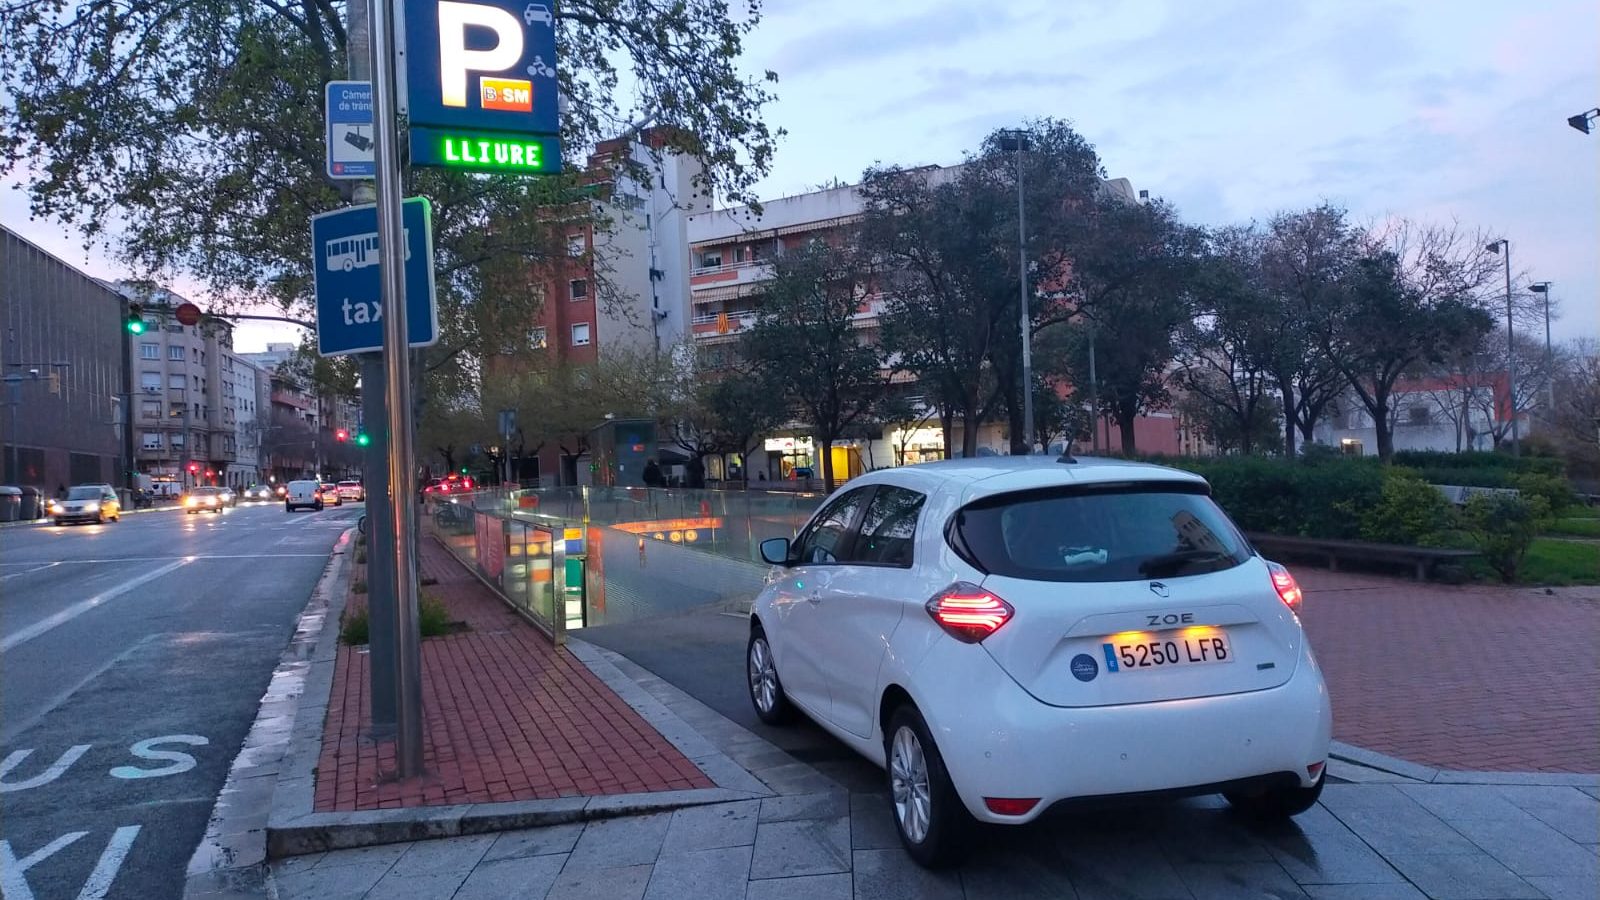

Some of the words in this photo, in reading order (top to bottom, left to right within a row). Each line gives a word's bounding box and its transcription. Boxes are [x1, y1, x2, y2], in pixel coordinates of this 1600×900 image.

[438, 1, 523, 107] P
[338, 101, 350, 110] de
[342, 90, 371, 99] Càmer
[445, 139, 540, 166] LLIURE
[341, 297, 383, 325] tax
[1147, 613, 1195, 626] ZOE
[1109, 660, 1115, 668] E
[1120, 641, 1179, 668] 5250
[1185, 637, 1227, 662] LFB
[0, 734, 209, 793] US
